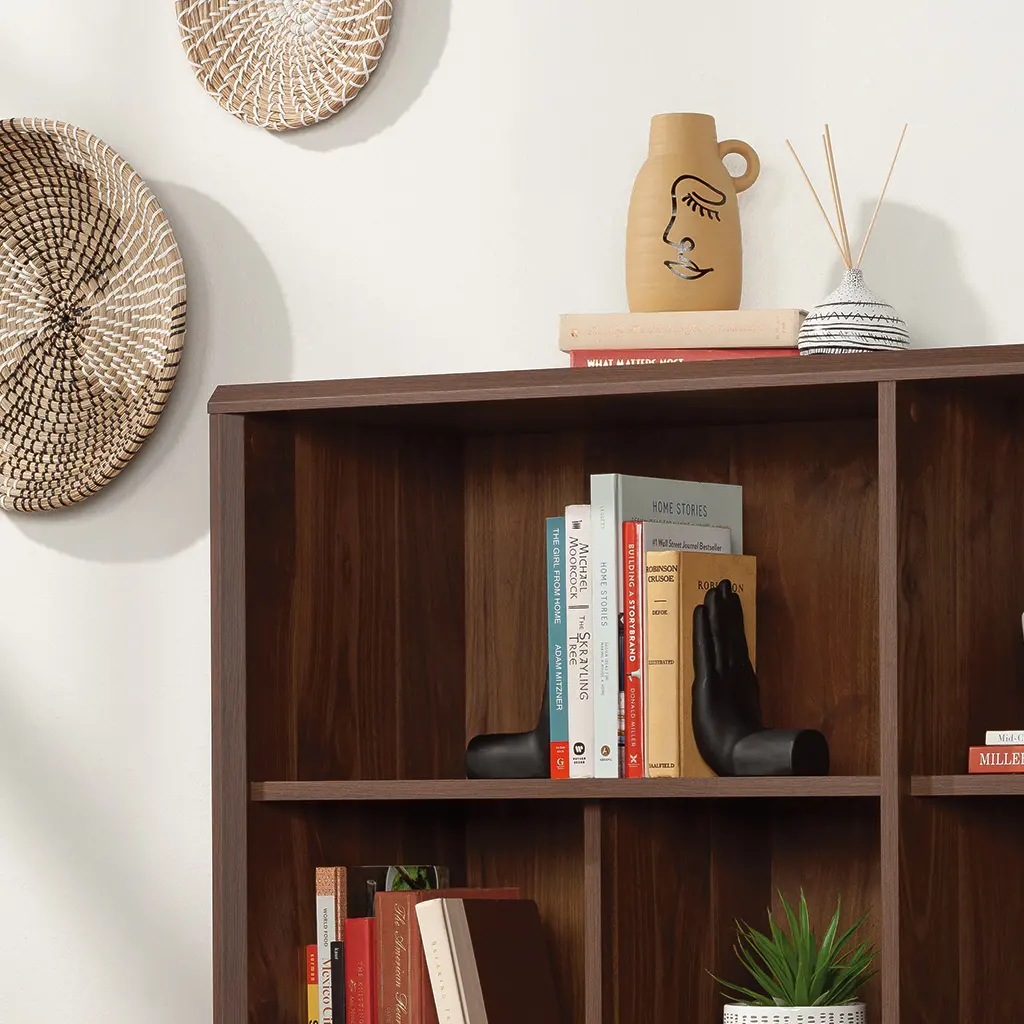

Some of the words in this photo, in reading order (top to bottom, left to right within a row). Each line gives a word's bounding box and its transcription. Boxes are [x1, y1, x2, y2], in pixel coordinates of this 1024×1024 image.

[587, 359, 614, 367] WHAT
[653, 500, 674, 514] HOME
[676, 503, 708, 518] STORIES
[658, 539, 667, 547] Wall
[669, 539, 682, 548] Street
[682, 541, 699, 549] Journal
[700, 542, 722, 551] Bestseller
[569, 536, 578, 599] MOORCOCK
[579, 543, 589, 592] MICHAEL
[698, 581, 744, 592] ROBION
[579, 632, 590, 700] SKRAYLING
[395, 903, 405, 926] The
[395, 930, 406, 988] American
[321, 958, 332, 1005] Mexico
